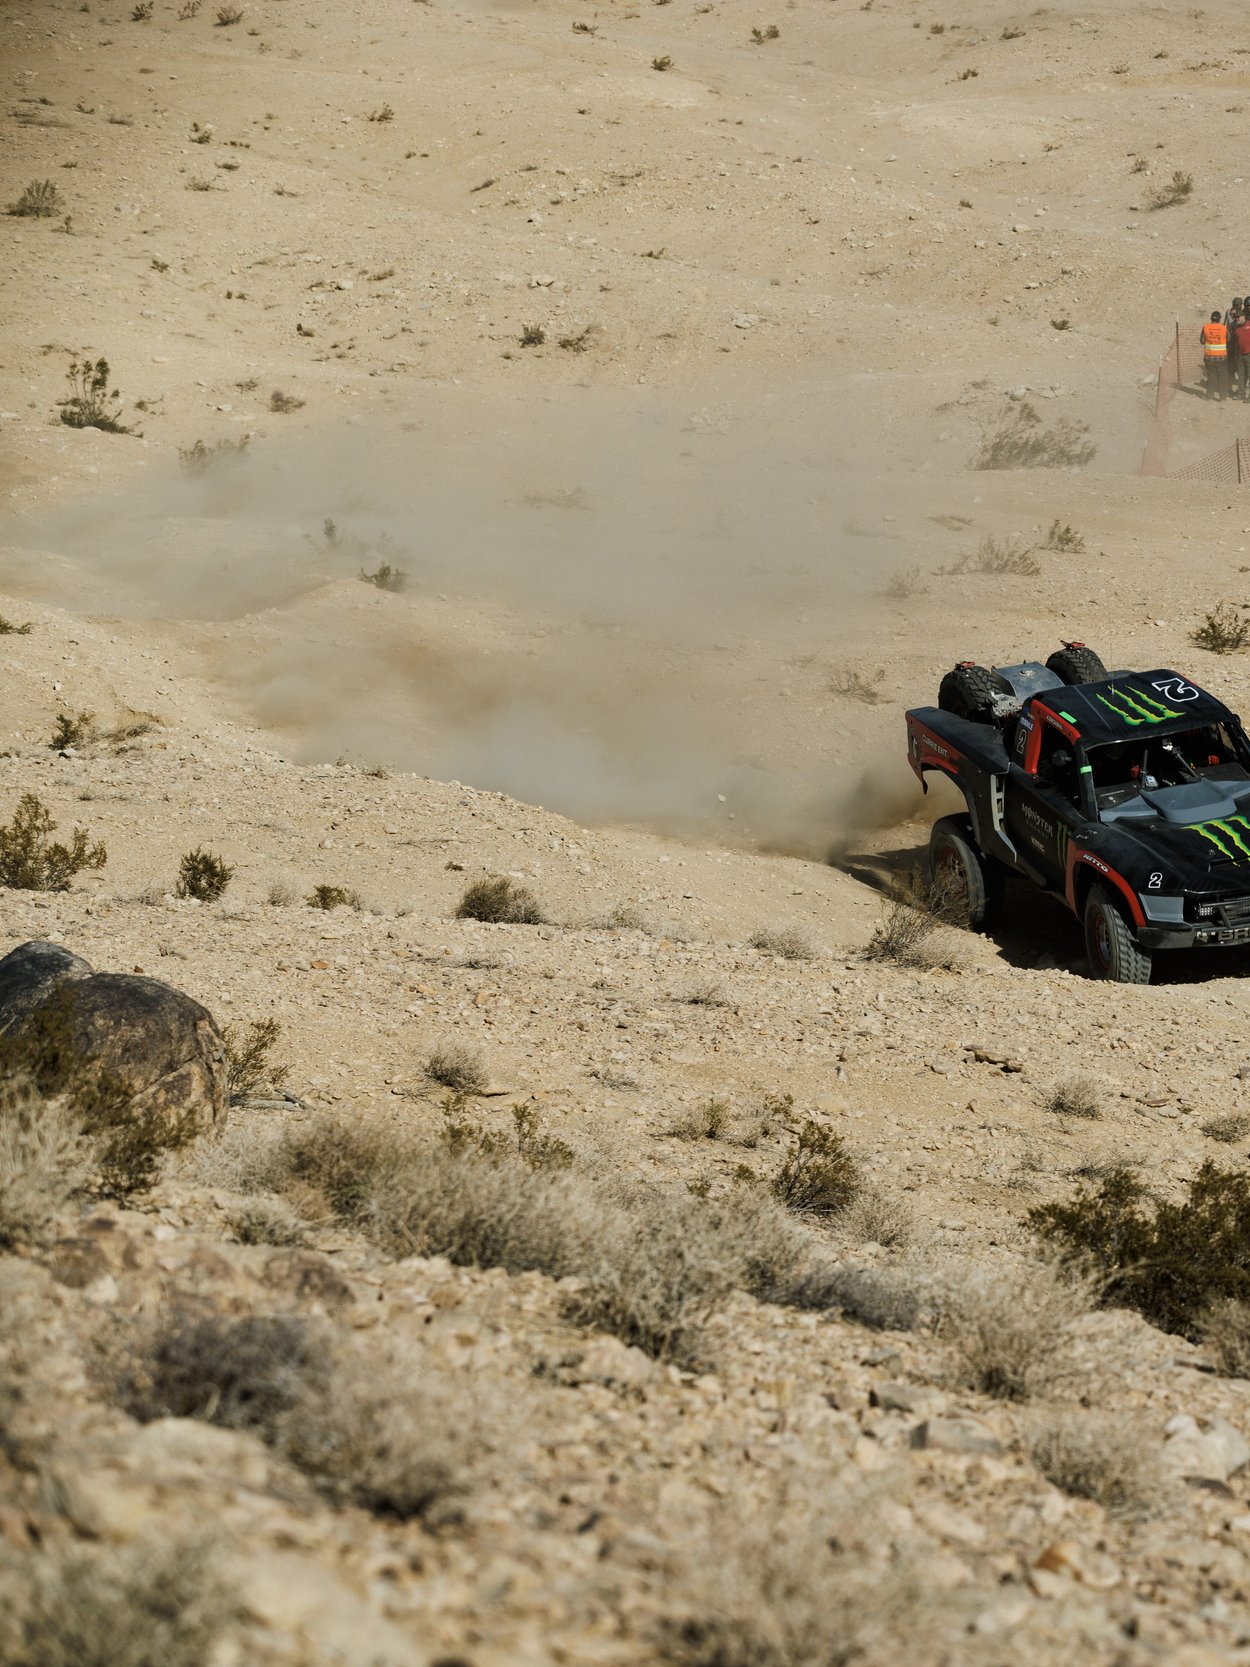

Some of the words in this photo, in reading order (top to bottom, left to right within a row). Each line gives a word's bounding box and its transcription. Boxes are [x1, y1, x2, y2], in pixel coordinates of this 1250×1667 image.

[1151, 677, 1199, 702] 2
[1016, 729, 1027, 755] 2
[1021, 803, 1054, 838] MONSTER
[1083, 853, 1109, 873] NITTO
[1148, 872, 1163, 889] 2
